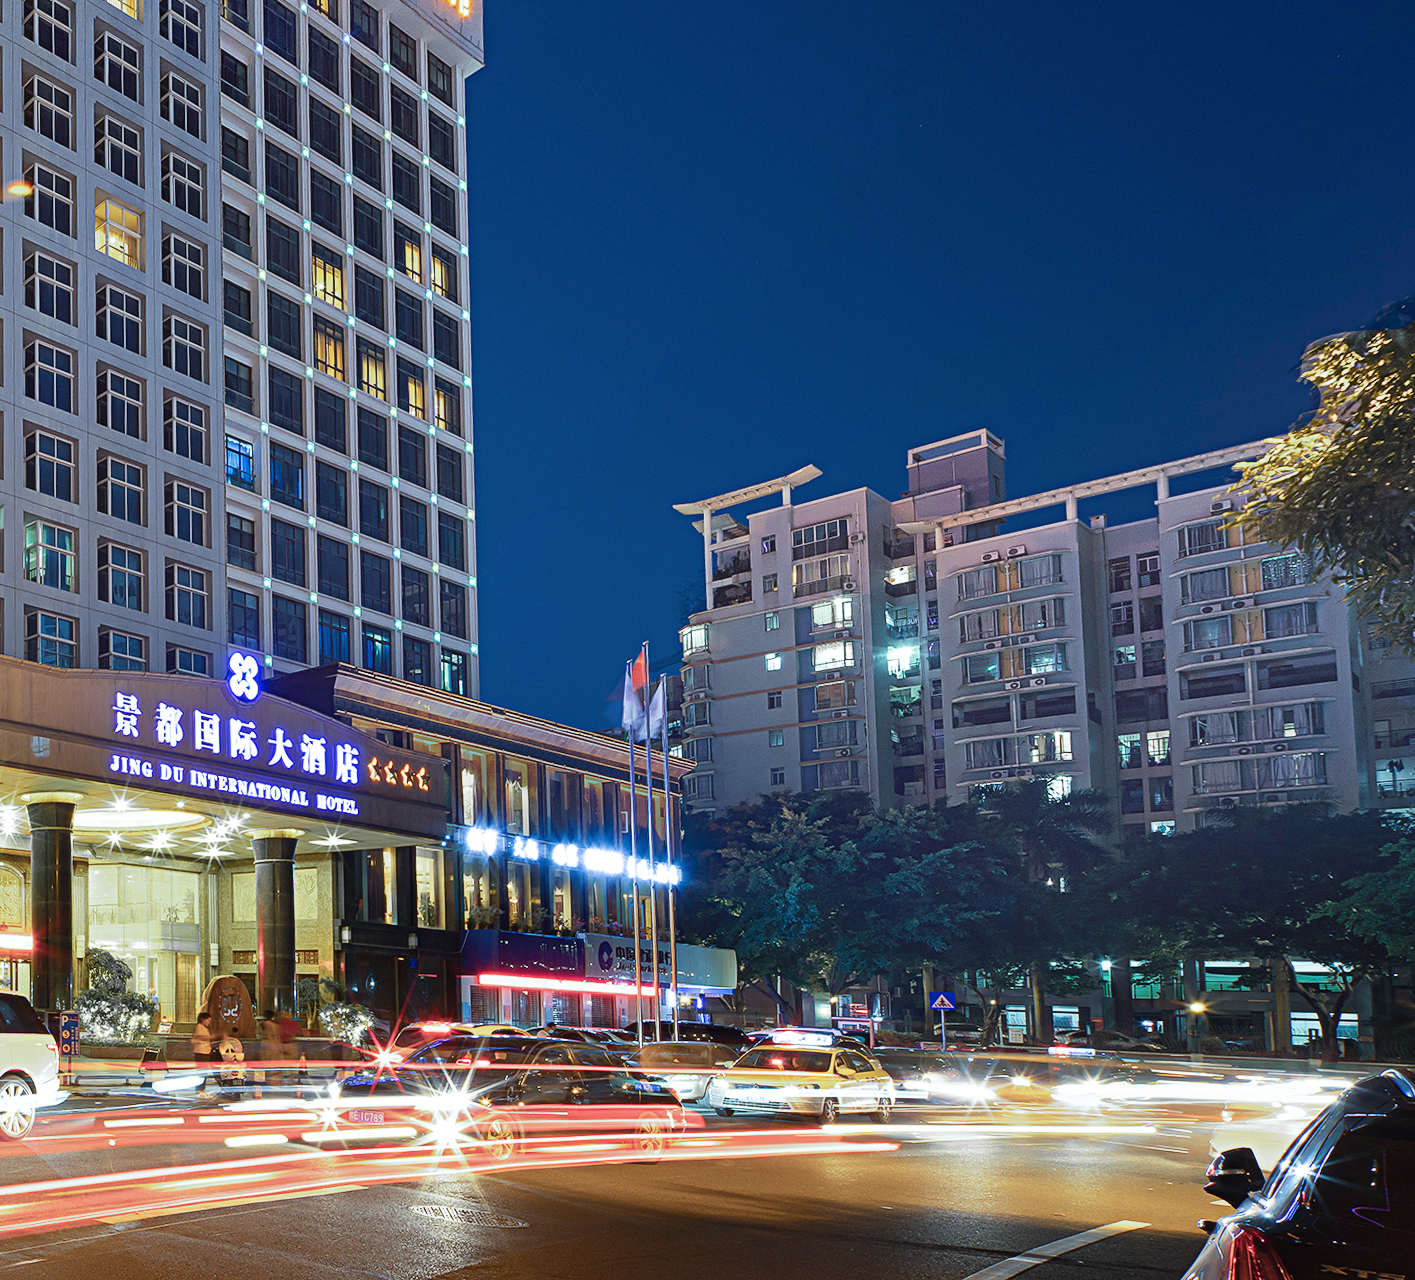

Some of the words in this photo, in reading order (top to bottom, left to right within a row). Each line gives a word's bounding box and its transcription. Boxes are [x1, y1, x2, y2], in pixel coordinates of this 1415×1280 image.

[112, 691, 360, 785] 景都国际大酒店
[110, 754, 153, 778] JING
[161, 763, 184, 783] DU
[190, 770, 308, 807] INTERNATIONAL
[316, 793, 359, 815] HOTEL
[62, 1015, 69, 1026] P
